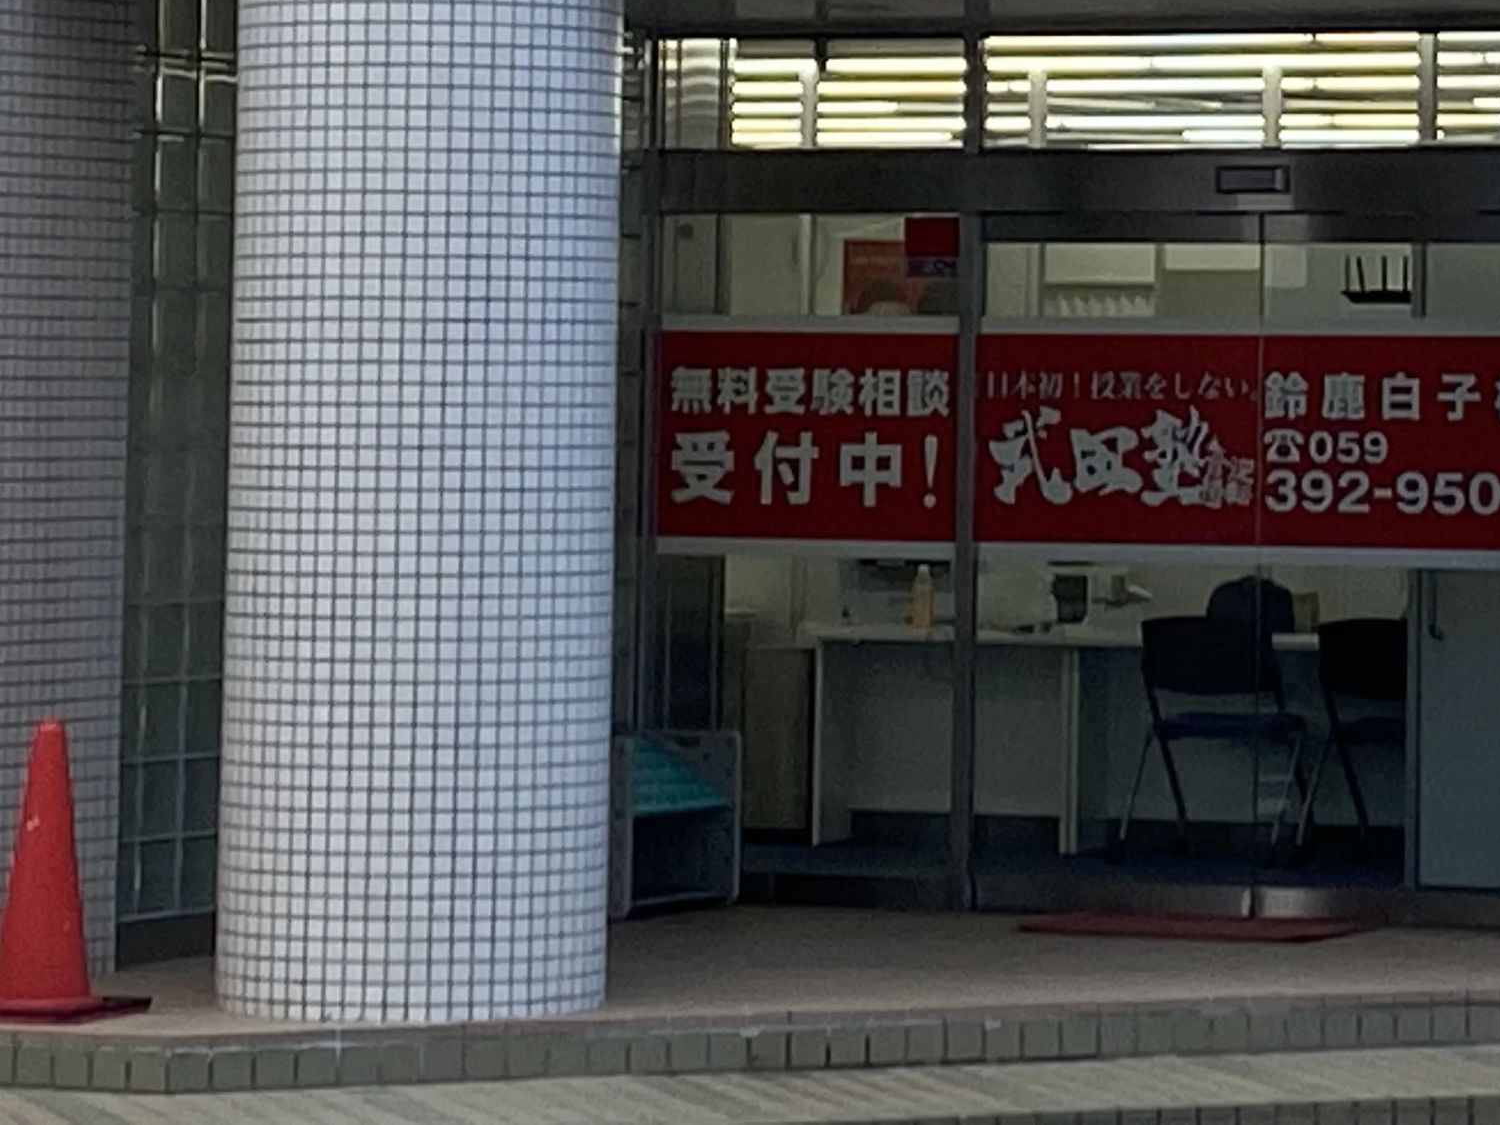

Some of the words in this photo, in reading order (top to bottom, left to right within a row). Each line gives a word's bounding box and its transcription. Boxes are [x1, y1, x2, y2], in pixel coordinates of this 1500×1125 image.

[670, 366, 950, 417] 無料受験相談
[670, 430, 939, 509] 受付中!
